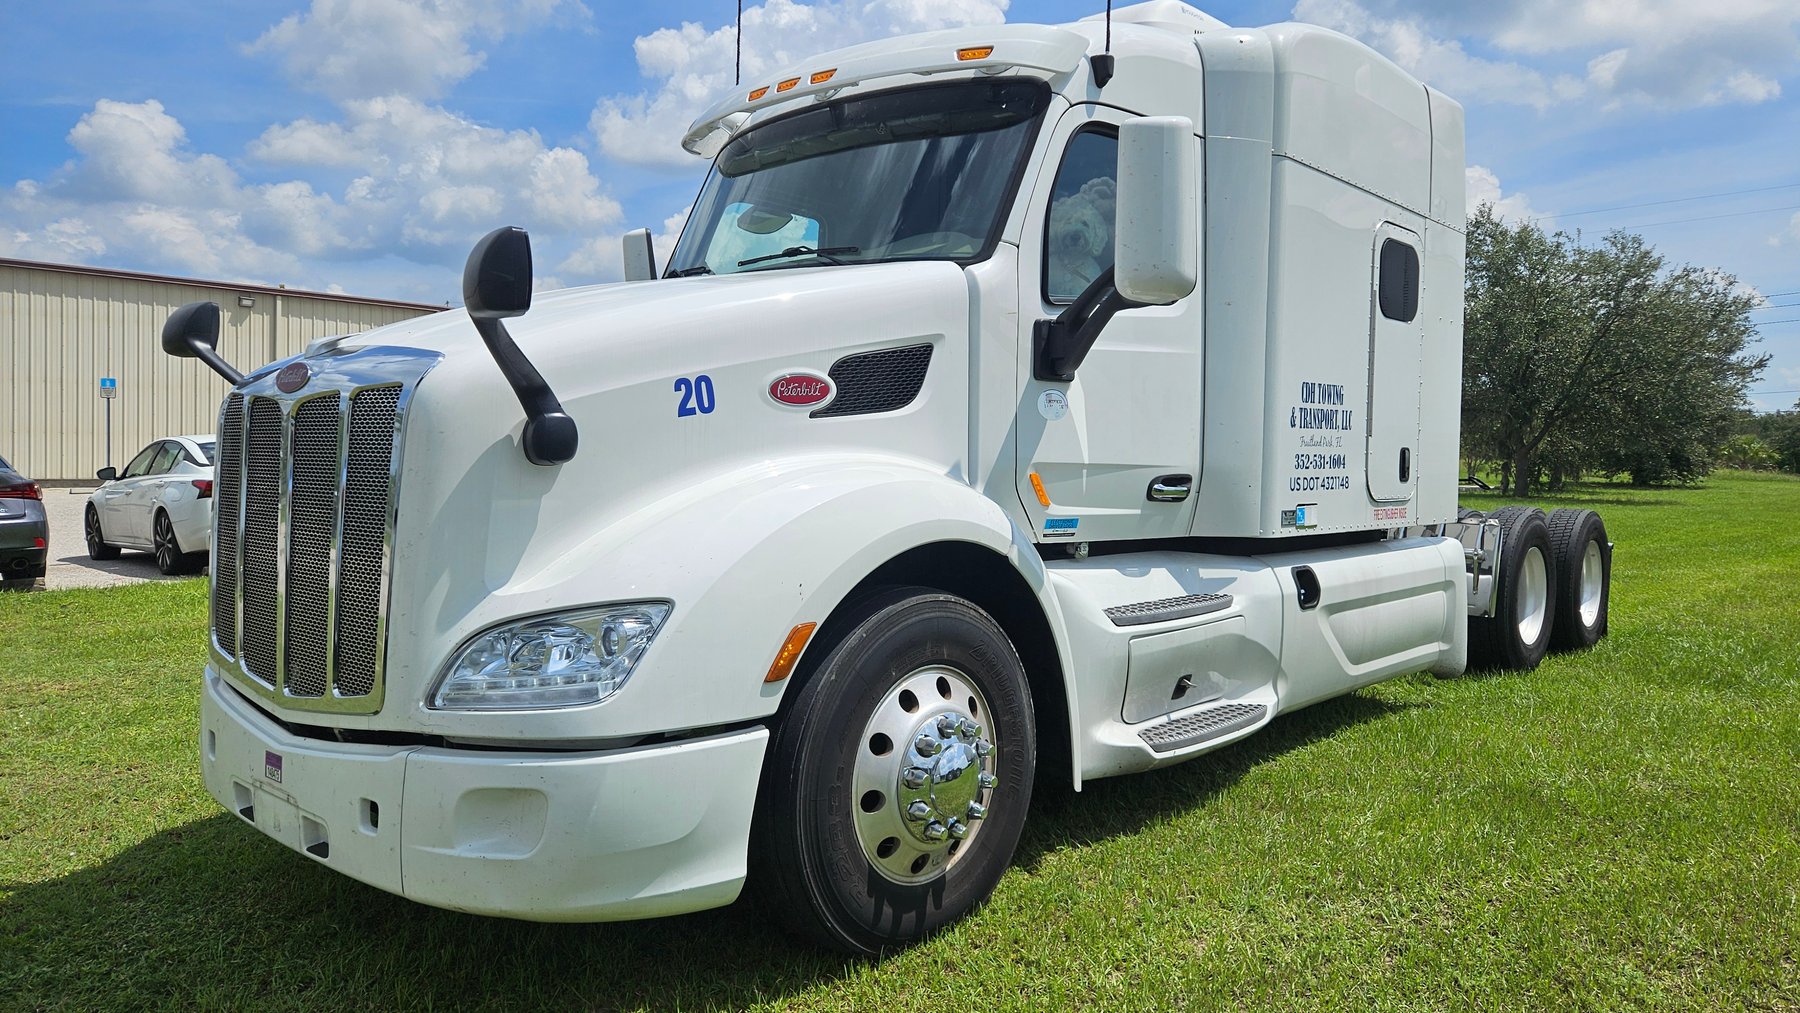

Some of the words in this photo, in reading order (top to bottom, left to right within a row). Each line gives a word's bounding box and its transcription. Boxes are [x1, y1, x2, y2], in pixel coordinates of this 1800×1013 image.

[674, 374, 715, 418] 20
[777, 381, 825, 398] Peterbilt
[1301, 381, 1316, 404] CDH
[1318, 383, 1344, 406] TOWING
[1290, 406, 1297, 428] &
[1299, 407, 1339, 432] TRANSPORT,
[1341, 410, 1353, 431] LLC
[1294, 453, 1346, 469] 352-531-1604
[1289, 476, 1301, 491] US
[1302, 476, 1320, 491] DOT
[1320, 475, 1350, 490] 4321148
